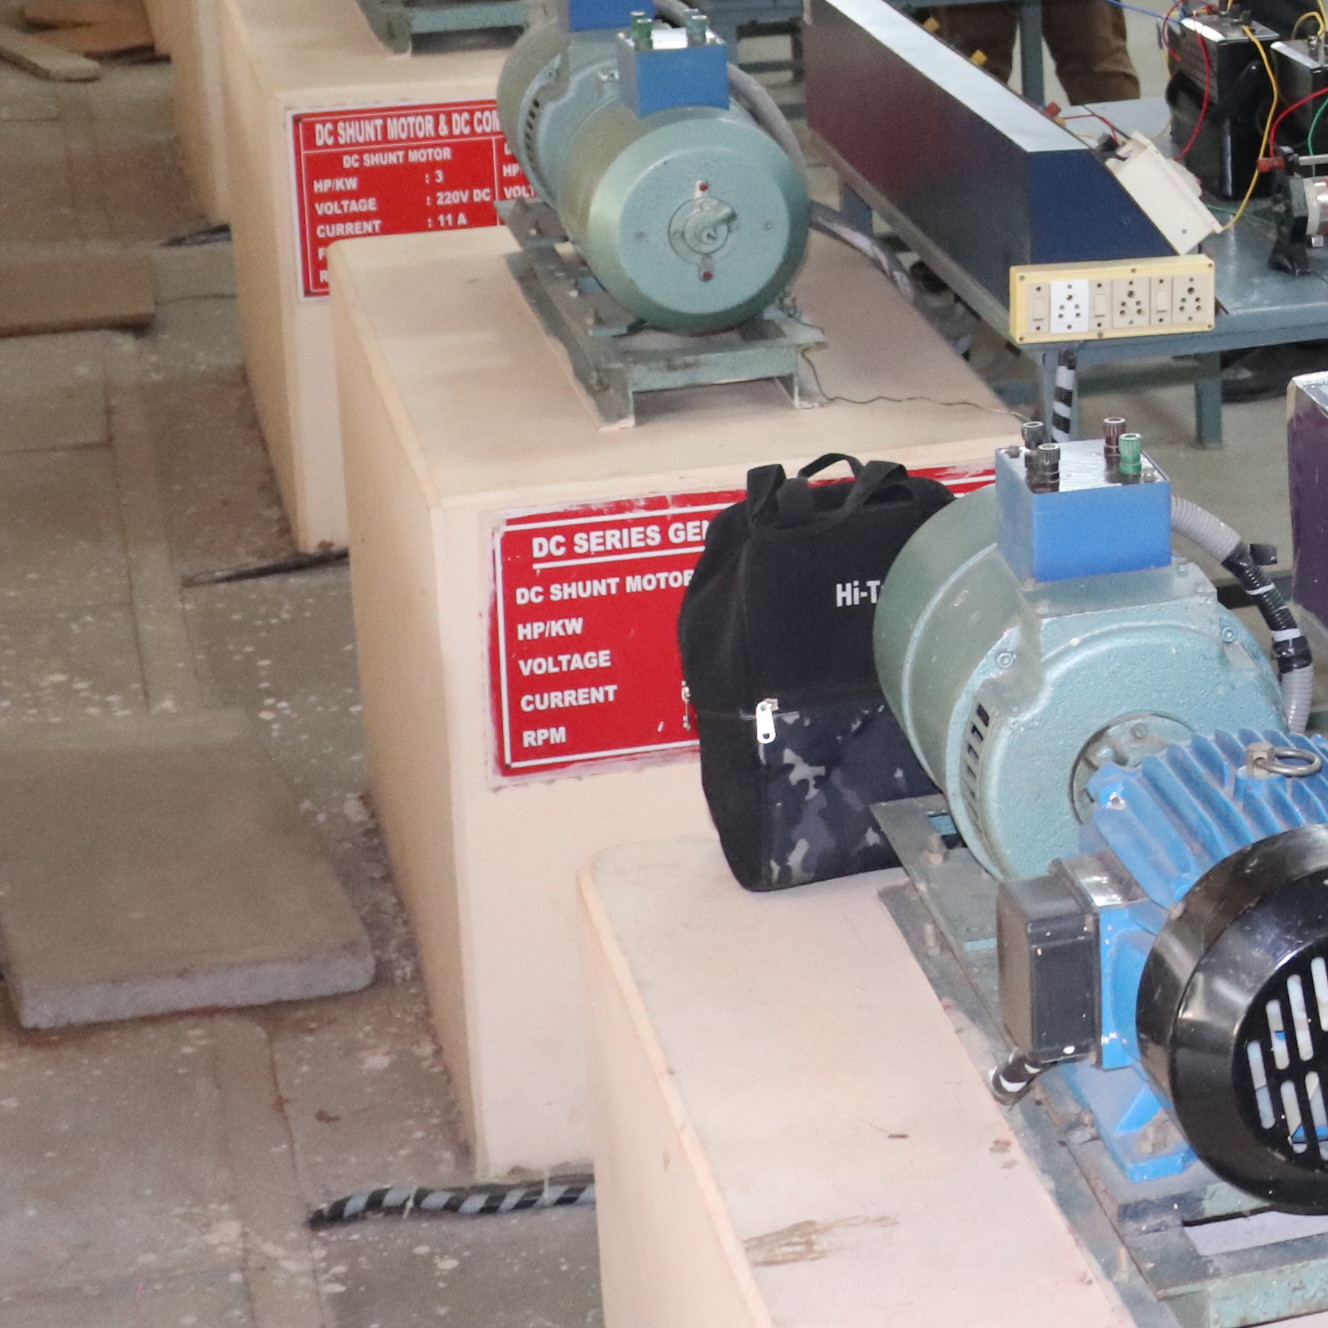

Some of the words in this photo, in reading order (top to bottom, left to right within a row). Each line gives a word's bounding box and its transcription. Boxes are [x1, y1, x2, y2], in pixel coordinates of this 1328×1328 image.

[315, 122, 335, 147] DC
[337, 118, 384, 144] SHUNT
[386, 114, 434, 141] MOTOR
[438, 115, 449, 136] &
[452, 113, 471, 134] DC
[343, 153, 360, 168] DC
[363, 150, 405, 166] SHUNT
[408, 147, 452, 162] MOTOR
[313, 177, 358, 193] HP/KW
[435, 170, 444, 183] 3
[314, 198, 377, 215] VOLTAGE
[436, 189, 469, 205] 220V
[472, 189, 491, 202] DC
[316, 220, 381, 238] CURRENT
[438, 213, 453, 226] 11
[457, 213, 467, 226] A
[532, 535, 566, 558] DC
[573, 525, 661, 554] SERIES
[516, 586, 544, 605] DC
[550, 577, 620, 602] SHUNT
[517, 617, 583, 641] HP/KW
[519, 650, 611, 676] VOLTAGE
[520, 685, 618, 712] CURRENT
[522, 727, 567, 748] RPM
